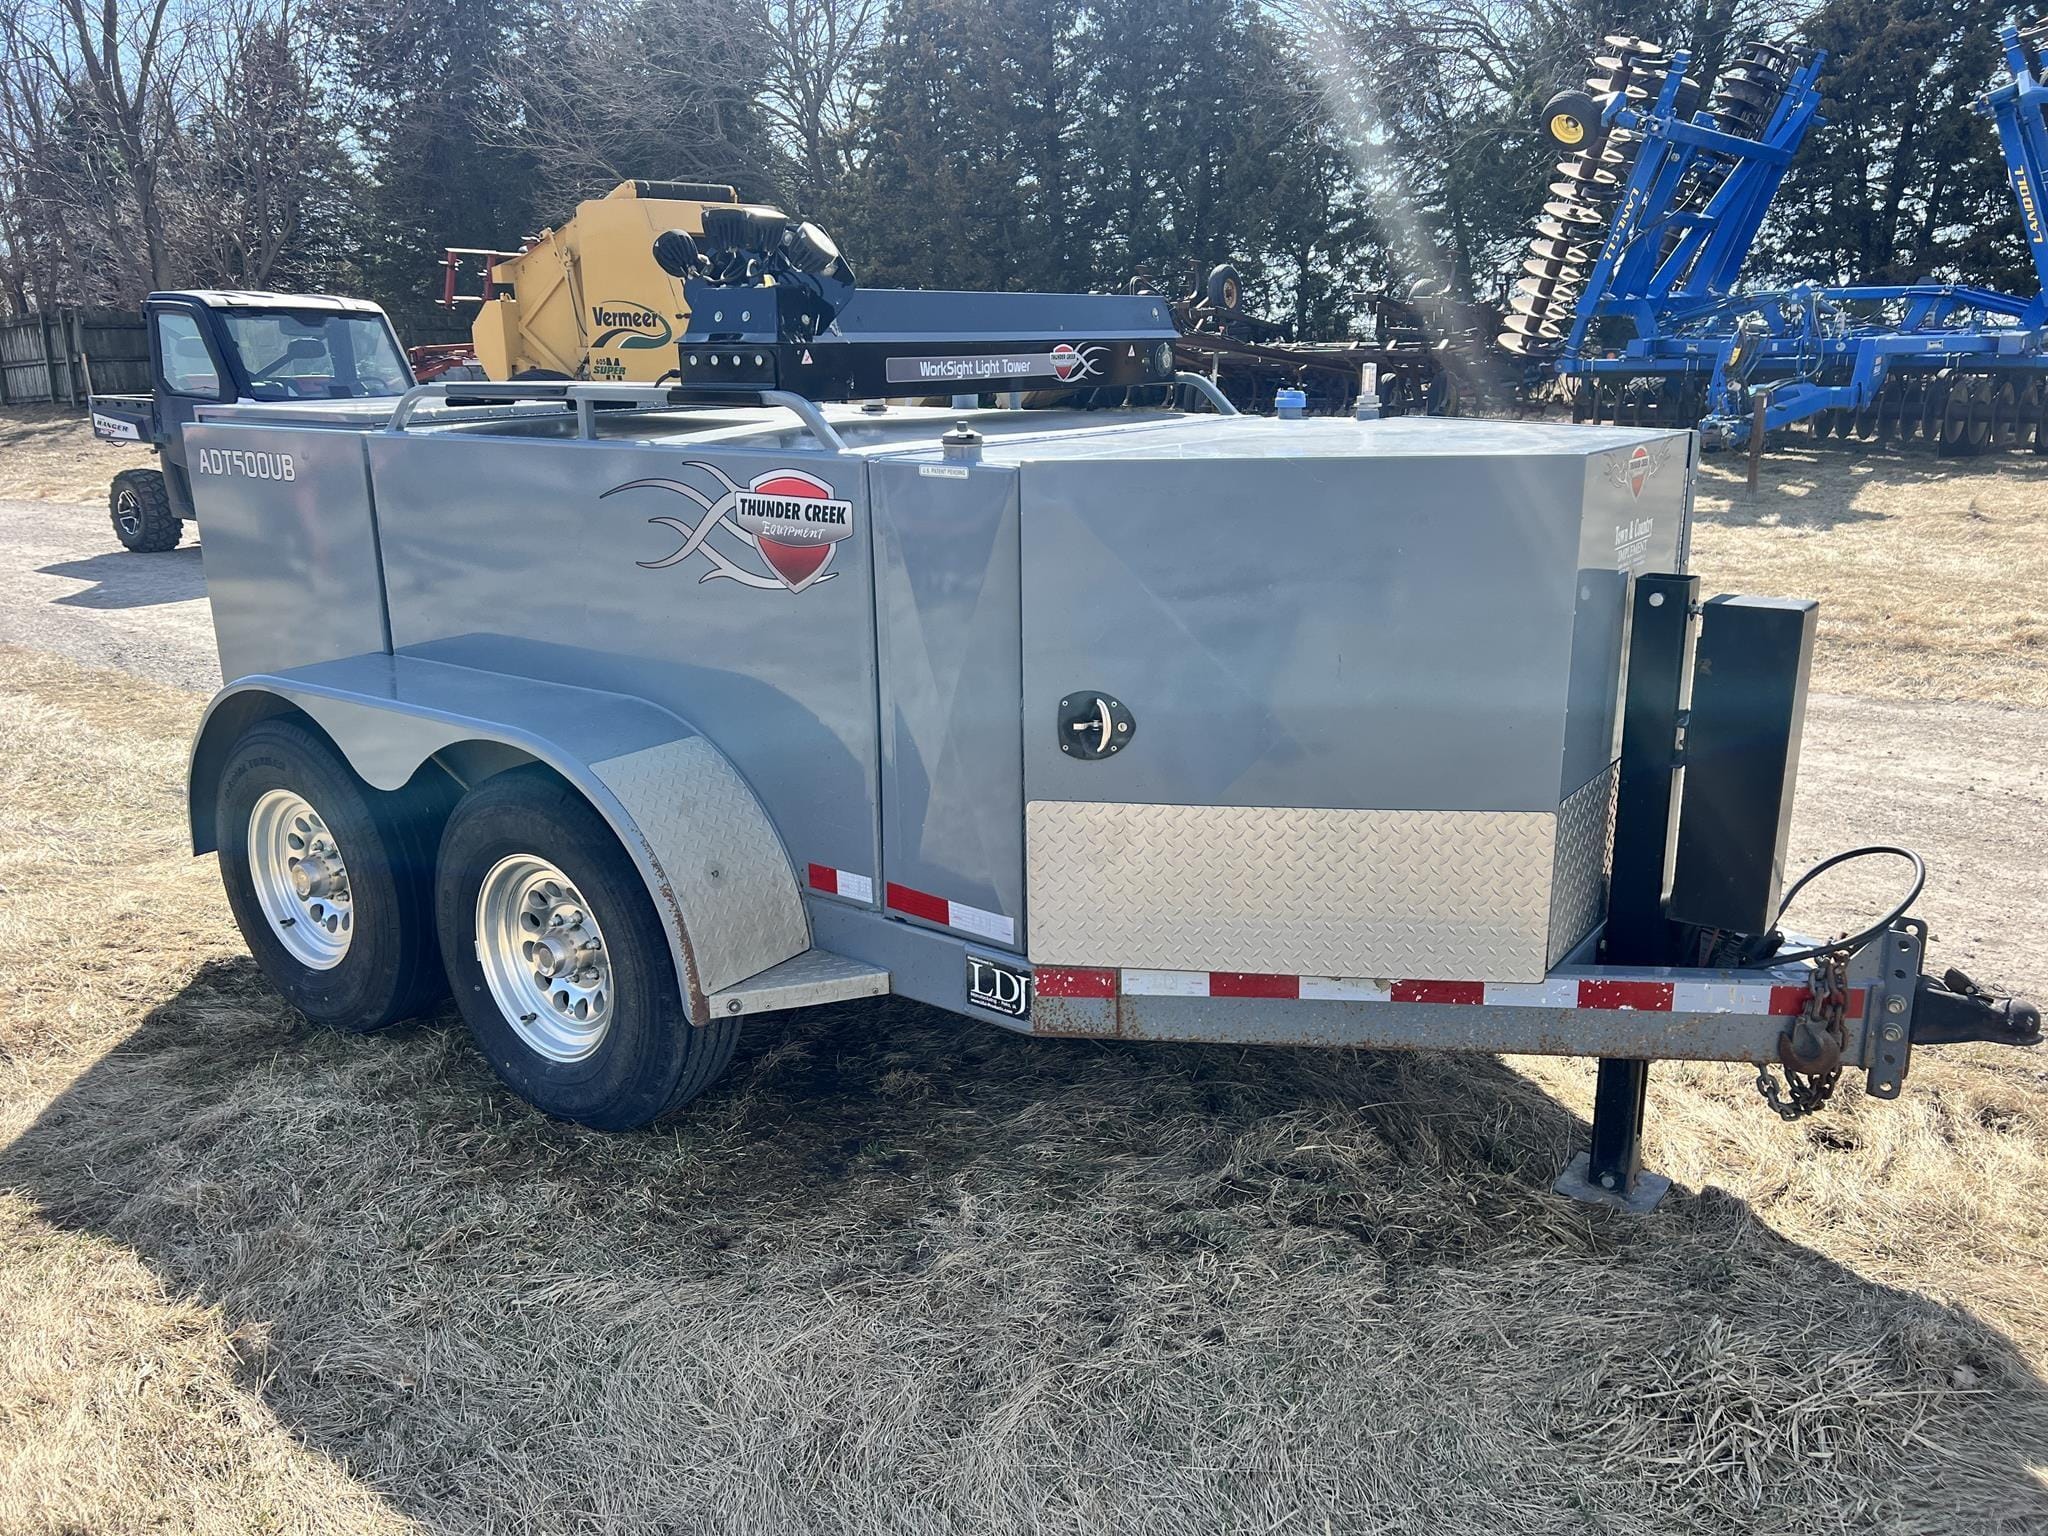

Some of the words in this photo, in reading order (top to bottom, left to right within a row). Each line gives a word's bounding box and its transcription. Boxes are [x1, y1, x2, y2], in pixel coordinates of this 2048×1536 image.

[2014, 165, 2043, 243] LANDOLL
[592, 307, 658, 327] Vermeer
[593, 365, 626, 375] SUPER
[919, 360, 973, 378] WorkSight
[975, 359, 1000, 377] Light
[1002, 358, 1031, 374] Tower
[97, 420, 128, 432] RANGER
[199, 448, 296, 482] ADT500UB
[740, 498, 801, 521] THUNDER
[804, 503, 847, 525] CREEK
[1617, 539, 1649, 562] IMPLEMENT
[970, 961, 1030, 1015] LDJ
